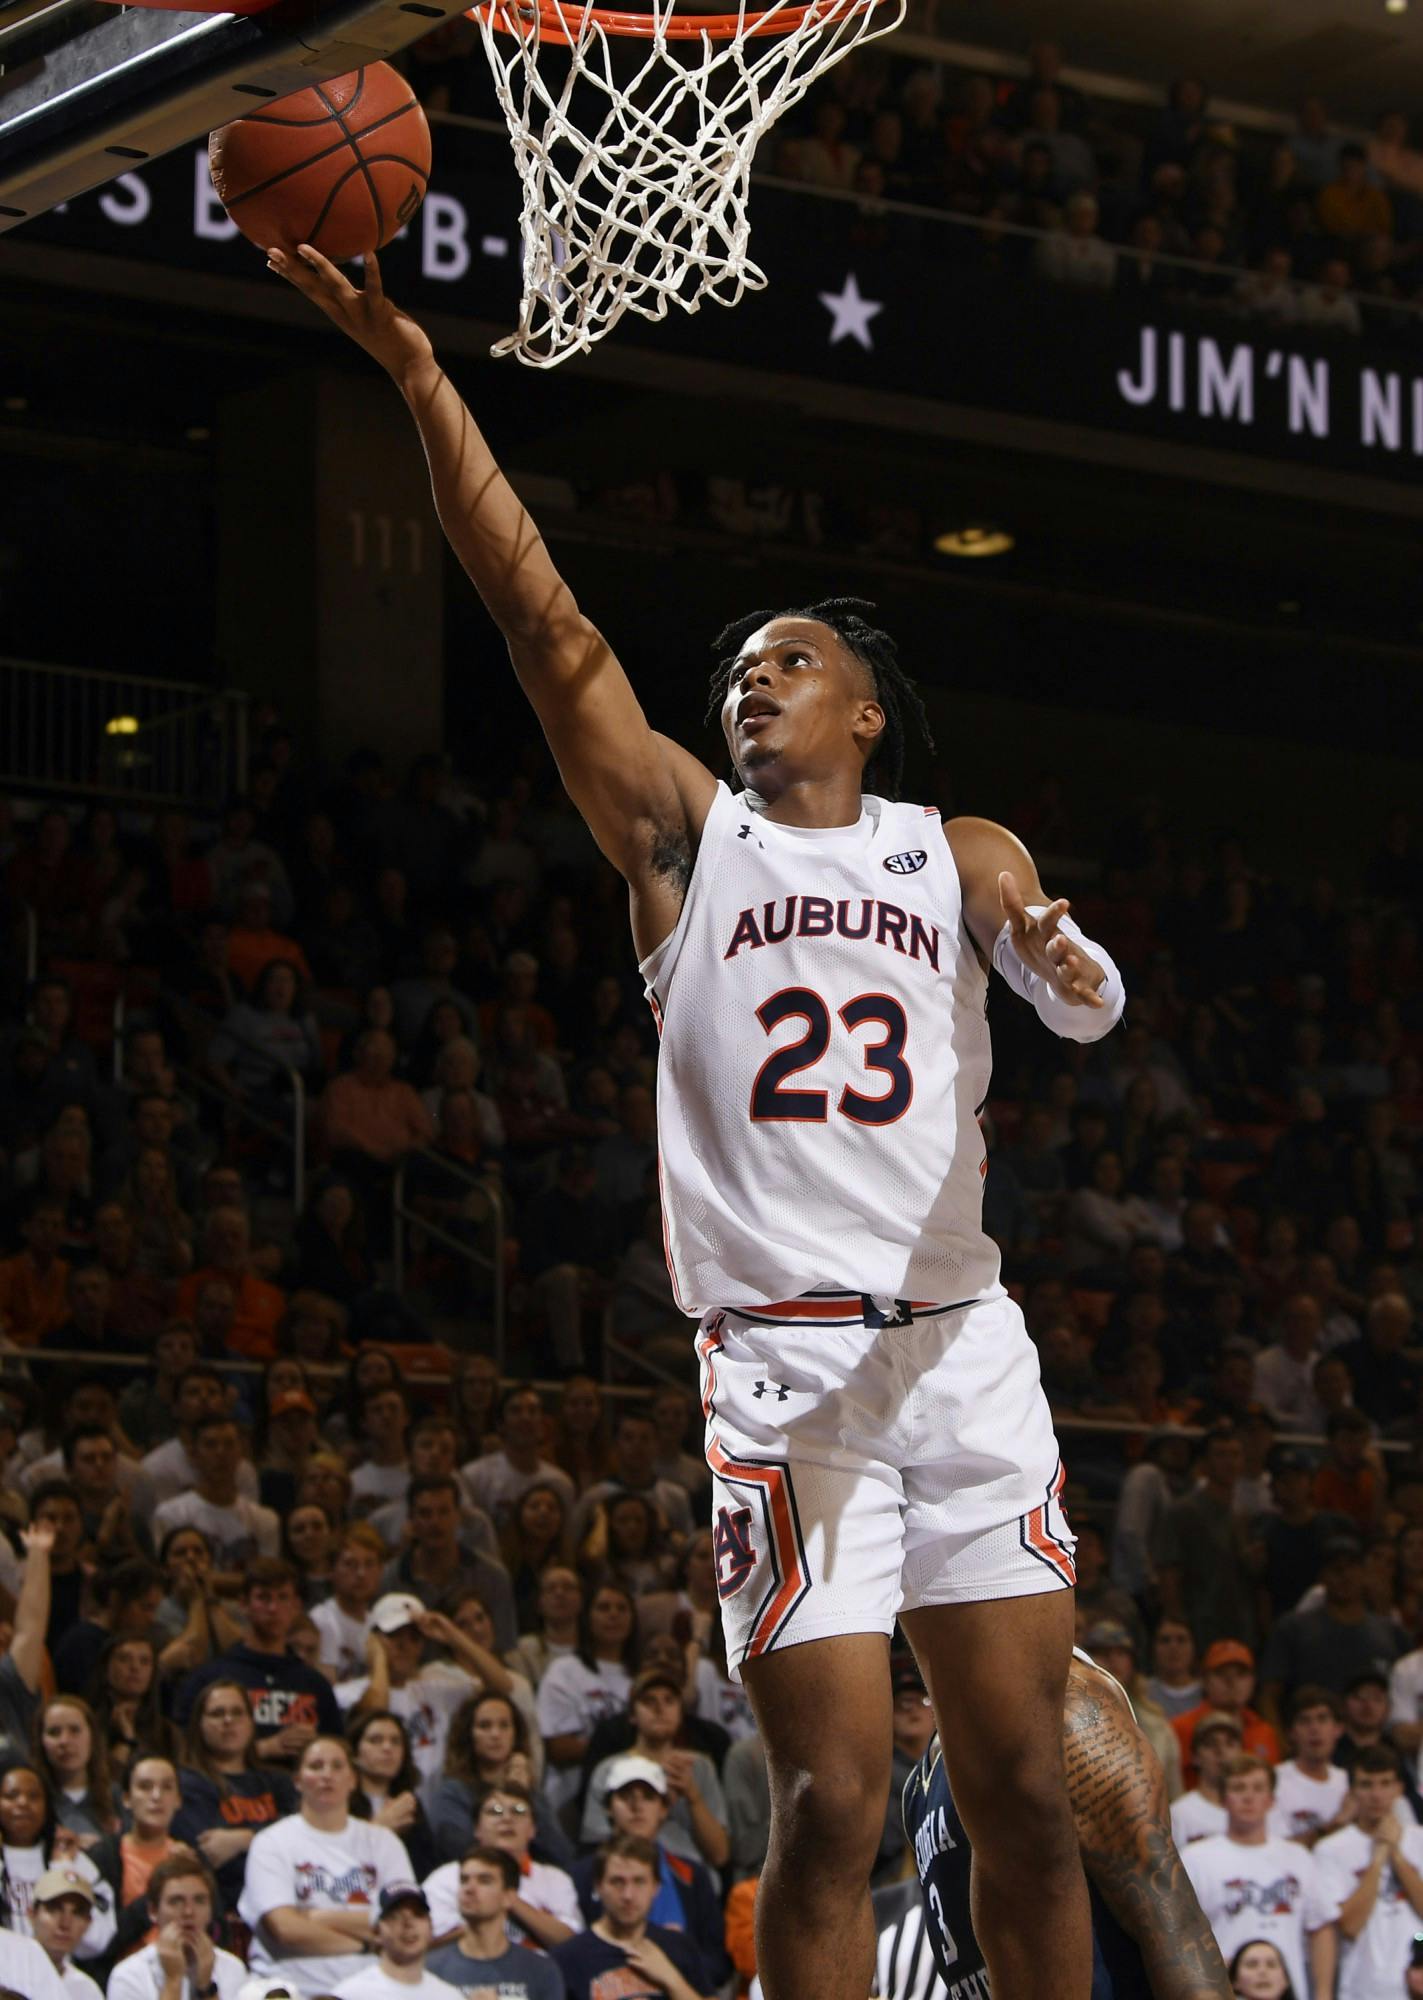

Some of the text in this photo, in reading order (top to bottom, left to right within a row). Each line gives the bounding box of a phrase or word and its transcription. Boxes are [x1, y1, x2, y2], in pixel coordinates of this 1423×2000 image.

[1116, 325, 1330, 440] JIM'N
[886, 851, 926, 873] SEC
[724, 895, 940, 974] AUBURN
[750, 986, 913, 1127] 23
[928, 1881, 959, 1967] 3
